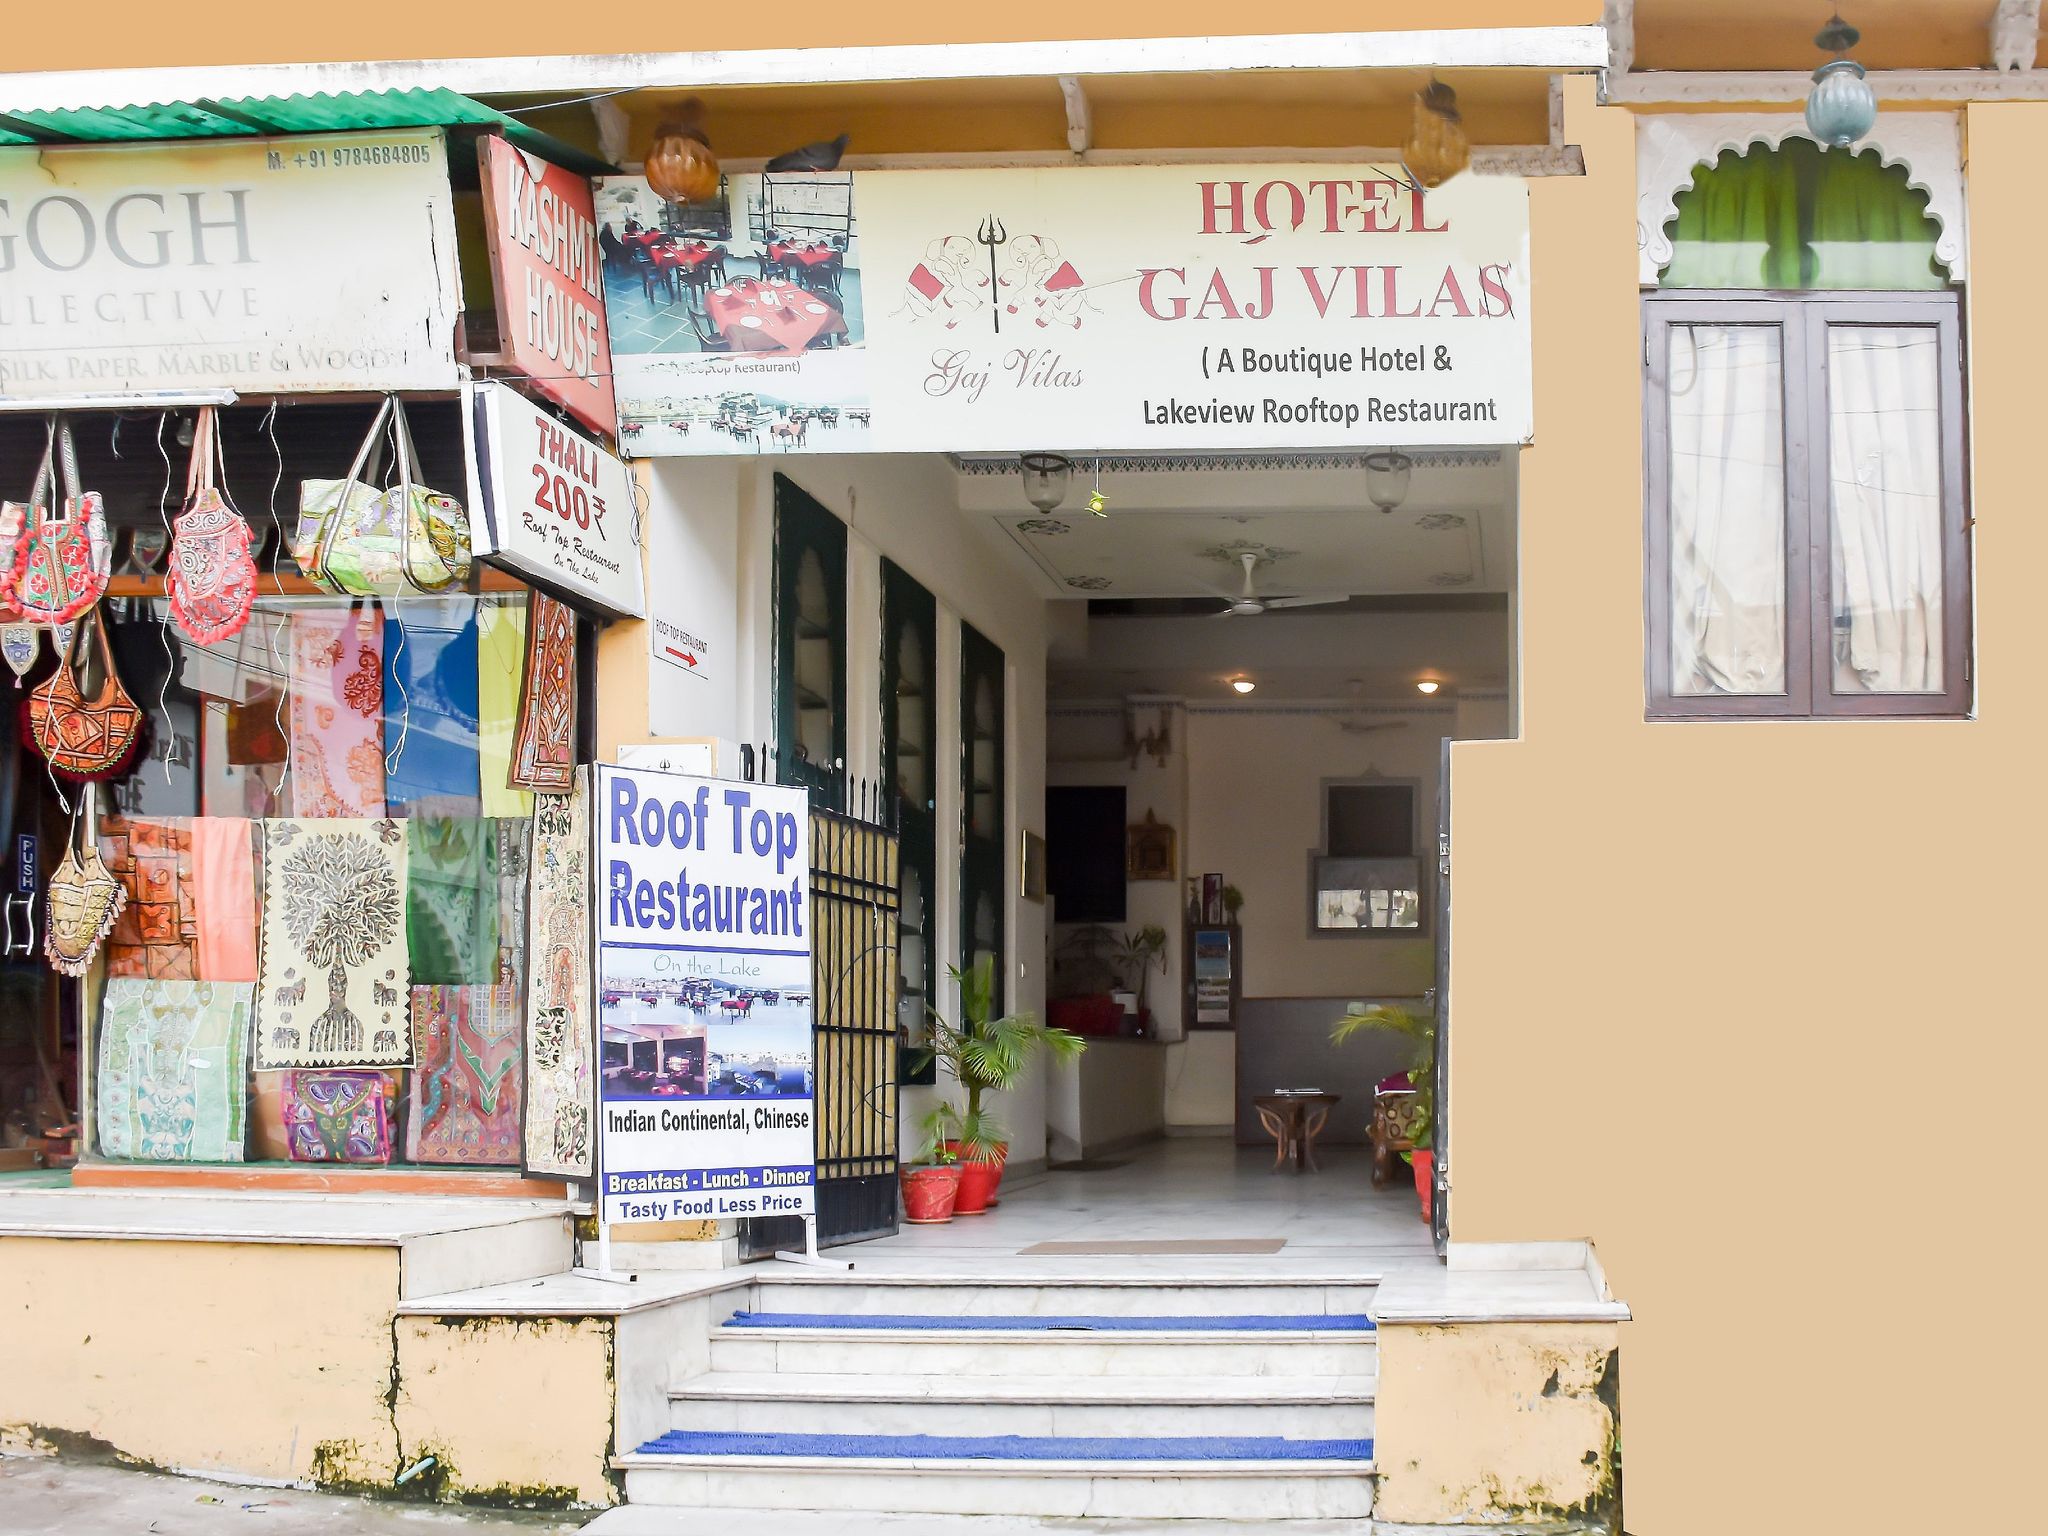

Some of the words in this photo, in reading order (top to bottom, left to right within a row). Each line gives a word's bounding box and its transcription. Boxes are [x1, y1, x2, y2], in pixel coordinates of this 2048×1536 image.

[294, 149, 326, 168] +91
[333, 145, 430, 167] 9784684805
[1195, 180, 1449, 236] HOTEL
[508, 158, 600, 302] KASHMI
[1136, 266, 1278, 321] GAJ
[1296, 263, 1515, 320] VILAS
[526, 266, 598, 388] HOUSE
[158, 351, 260, 376] MARBLE
[924, 348, 991, 404] Gaj
[1003, 348, 1084, 388] Vilas
[1217, 348, 1235, 373] A
[1242, 346, 1352, 378] Boutique
[1361, 344, 1425, 372] Hotel
[1433, 344, 1453, 372] &
[1144, 398, 1255, 425] Lakeview
[1263, 396, 1359, 428] Rooftop
[1367, 396, 1497, 423] Restaurant
[535, 416, 598, 488] THALI
[522, 511, 547, 542] Roof
[551, 525, 570, 551] Top
[656, 618, 669, 636] ROOF
[670, 624, 680, 641] TOP
[611, 777, 710, 851] Roof
[724, 789, 798, 875] Top
[22, 840, 33, 887] PUSH
[609, 860, 803, 938] Restaurant
[653, 953, 681, 973] On
[686, 955, 712, 974] the
[718, 957, 761, 977] Lake
[608, 1109, 656, 1133] Indian
[661, 1108, 750, 1135] Continental,
[754, 1107, 809, 1130] Chinese
[608, 1172, 689, 1193] Breakfast
[702, 1169, 750, 1189] Lunch
[762, 1168, 811, 1186] Dinner
[620, 1201, 667, 1221] Tasty
[673, 1197, 713, 1216] Food
[719, 1197, 756, 1213] Less
[762, 1194, 802, 1211] Price
